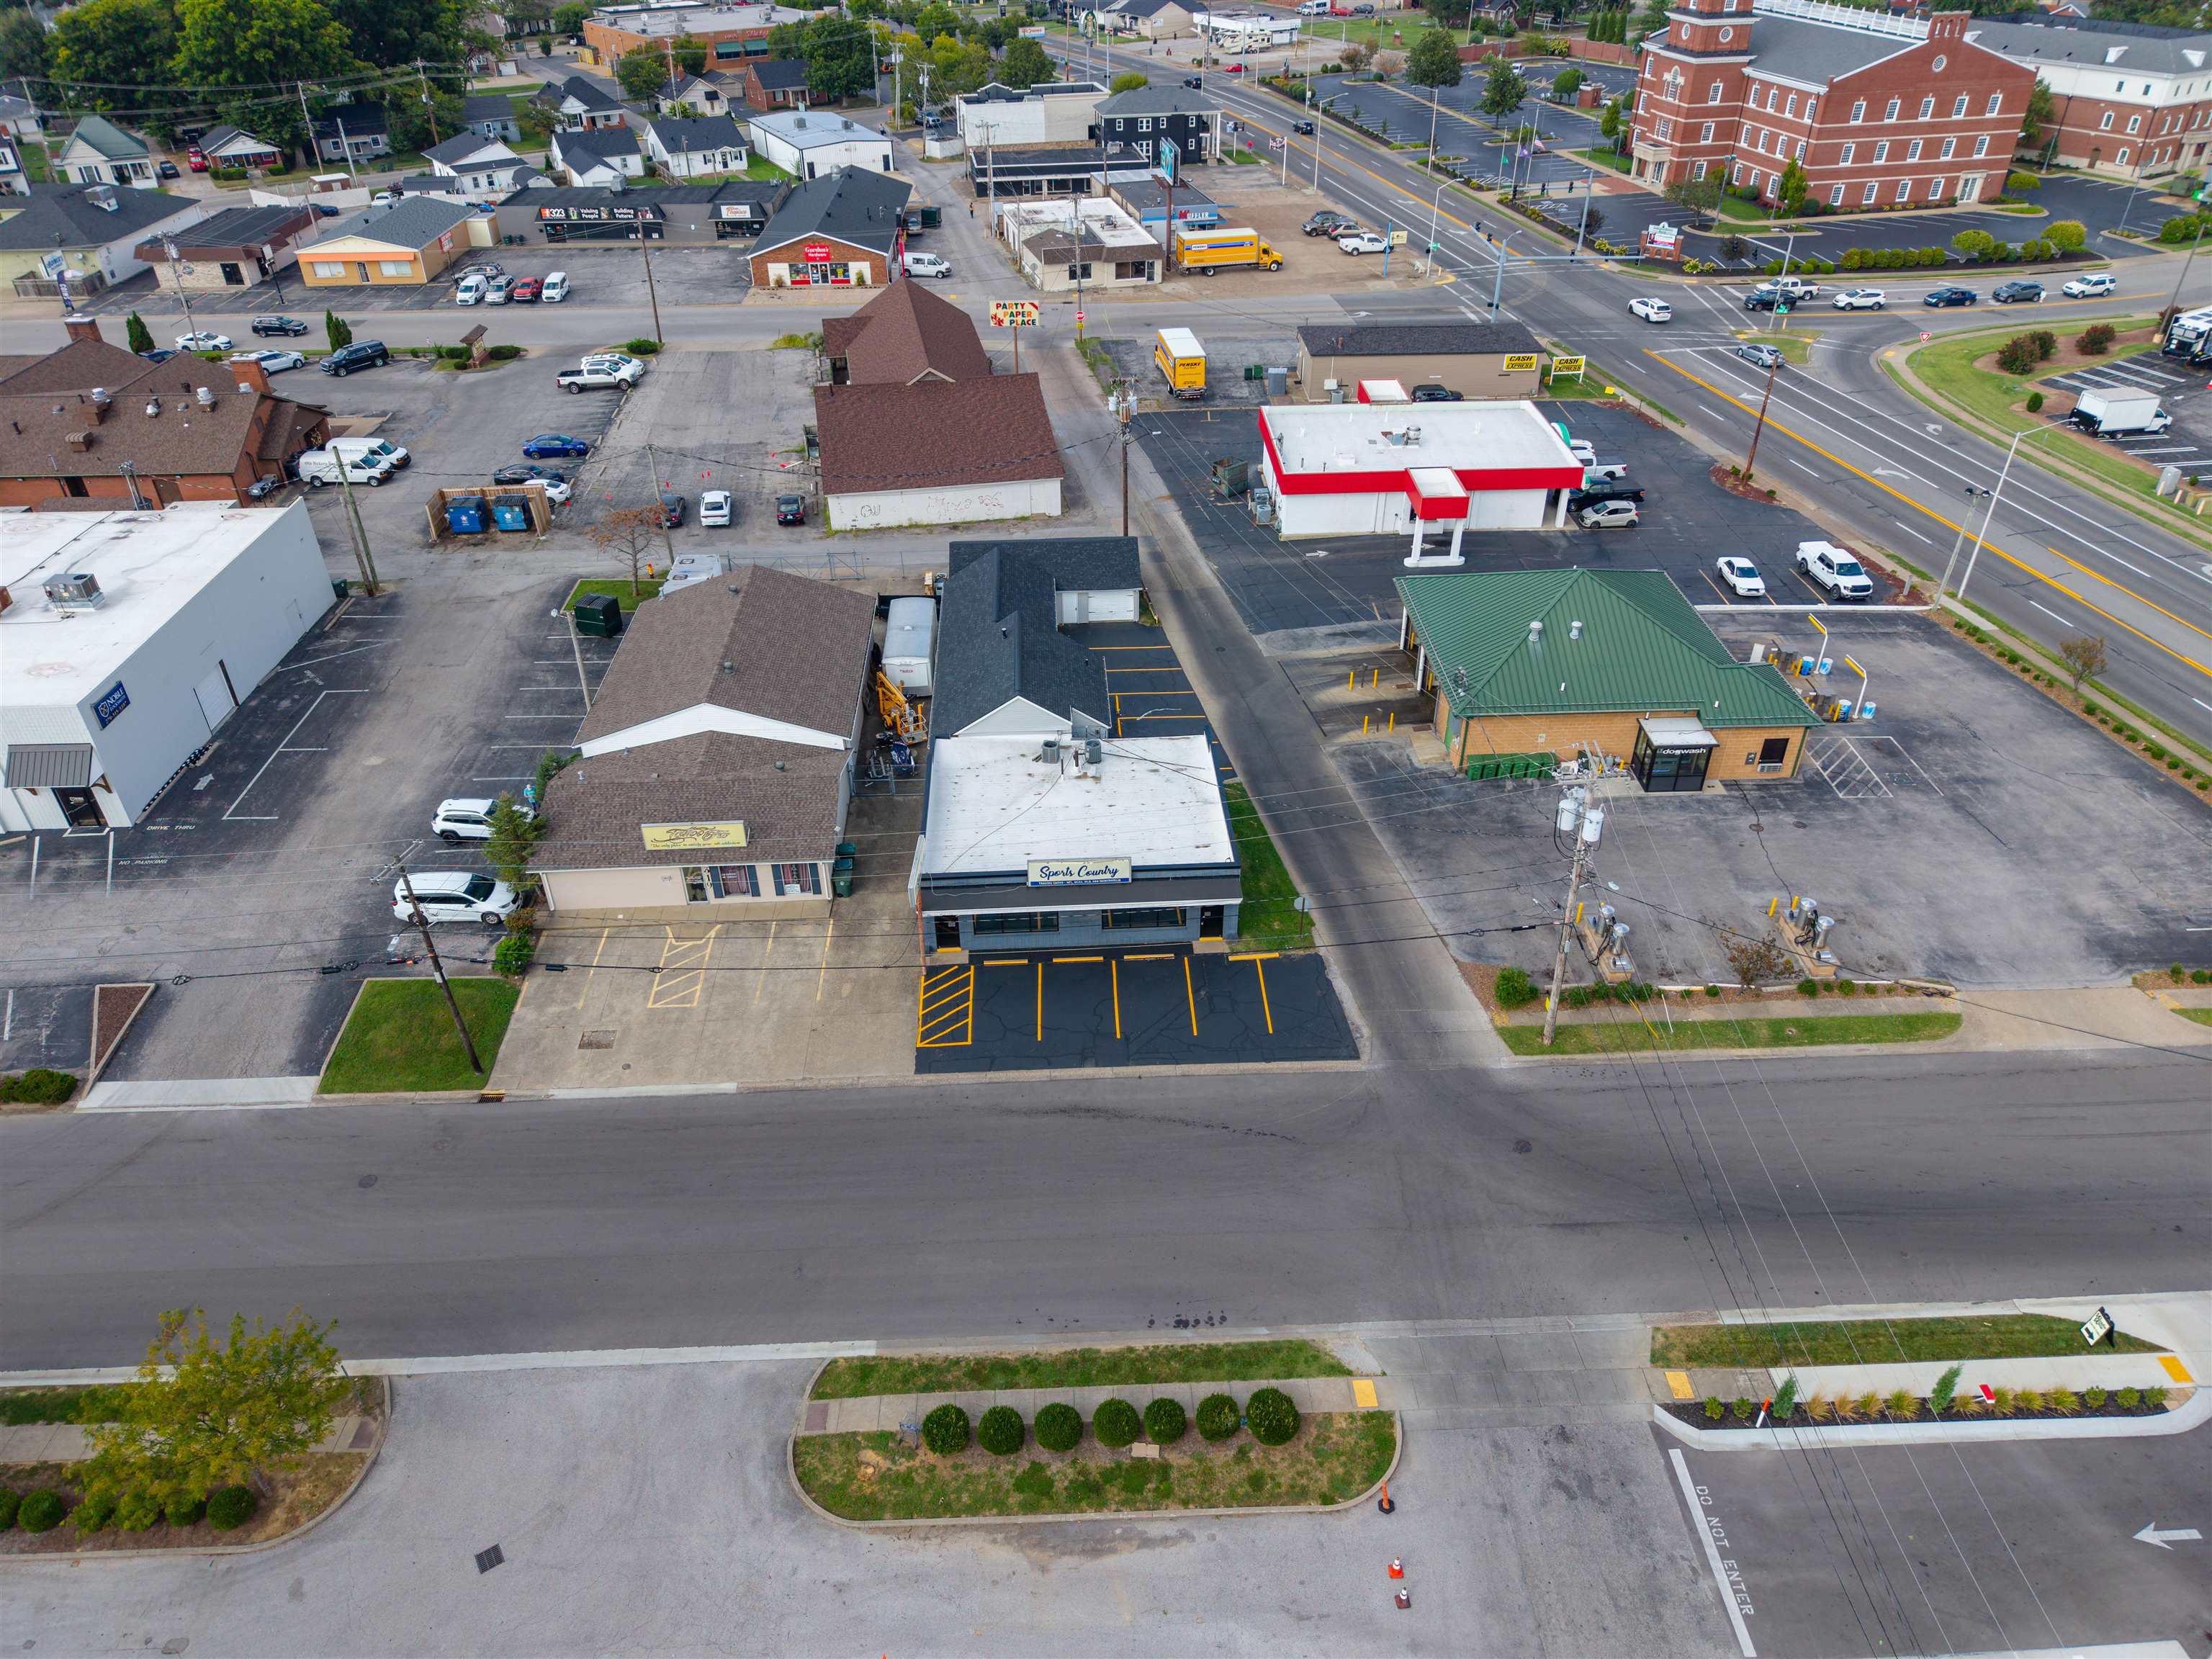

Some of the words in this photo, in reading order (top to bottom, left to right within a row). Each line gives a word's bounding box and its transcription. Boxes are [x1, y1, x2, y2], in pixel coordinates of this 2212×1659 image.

[550, 208, 565, 217] 323
[107, 687, 124, 706] NOBLE
[1039, 866, 1075, 880] Sports
[1078, 865, 1119, 878] Country
[1696, 1485, 1712, 1505] DO
[1707, 1516, 1730, 1548] NOT
[1723, 1560, 1755, 1615] ENTER
